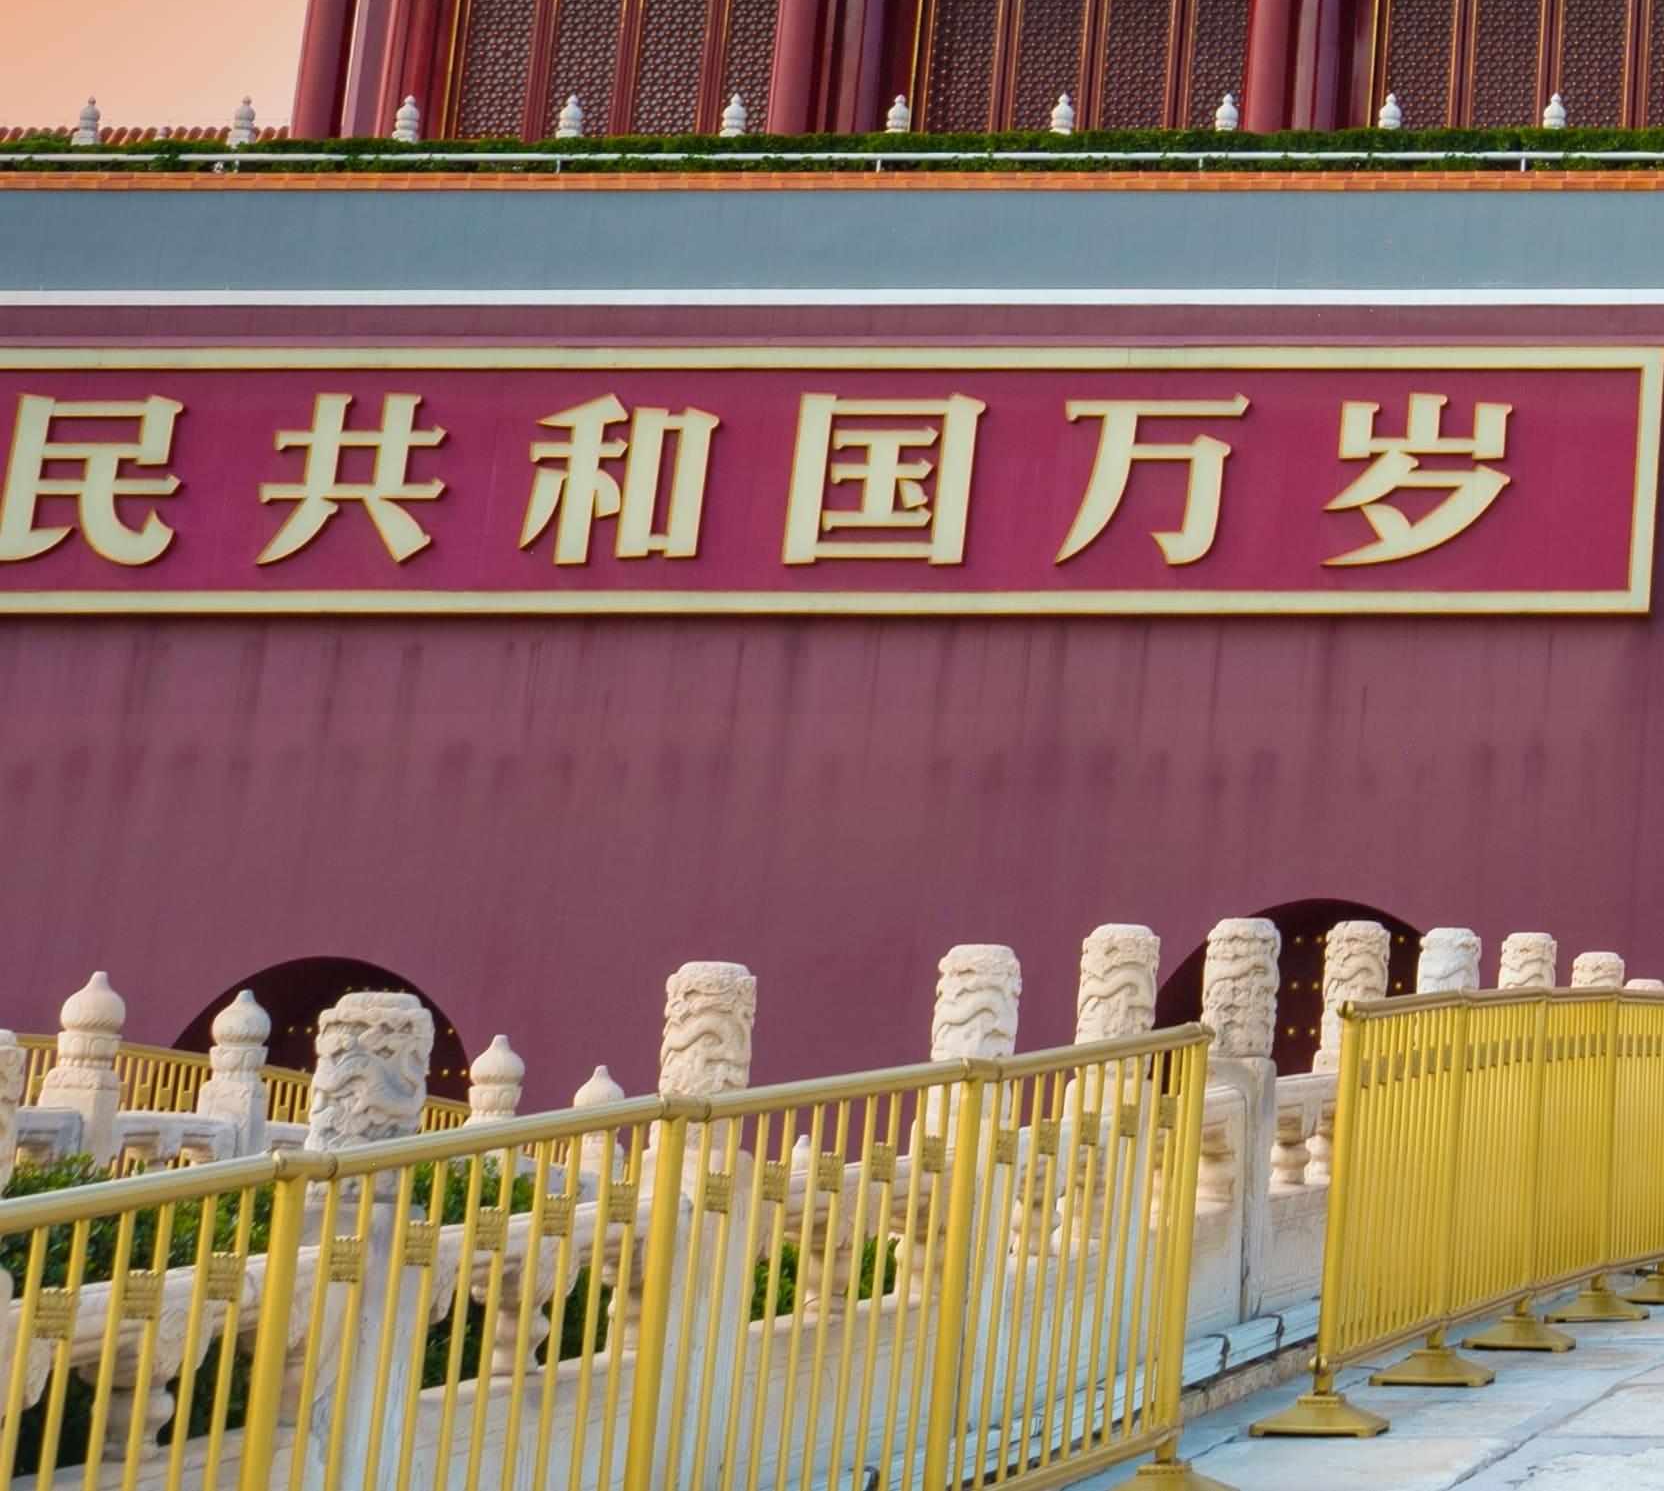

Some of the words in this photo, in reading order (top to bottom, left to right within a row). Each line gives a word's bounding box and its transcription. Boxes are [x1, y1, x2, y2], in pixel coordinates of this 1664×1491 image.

[0, 393, 1514, 565] 民共和国万岁
